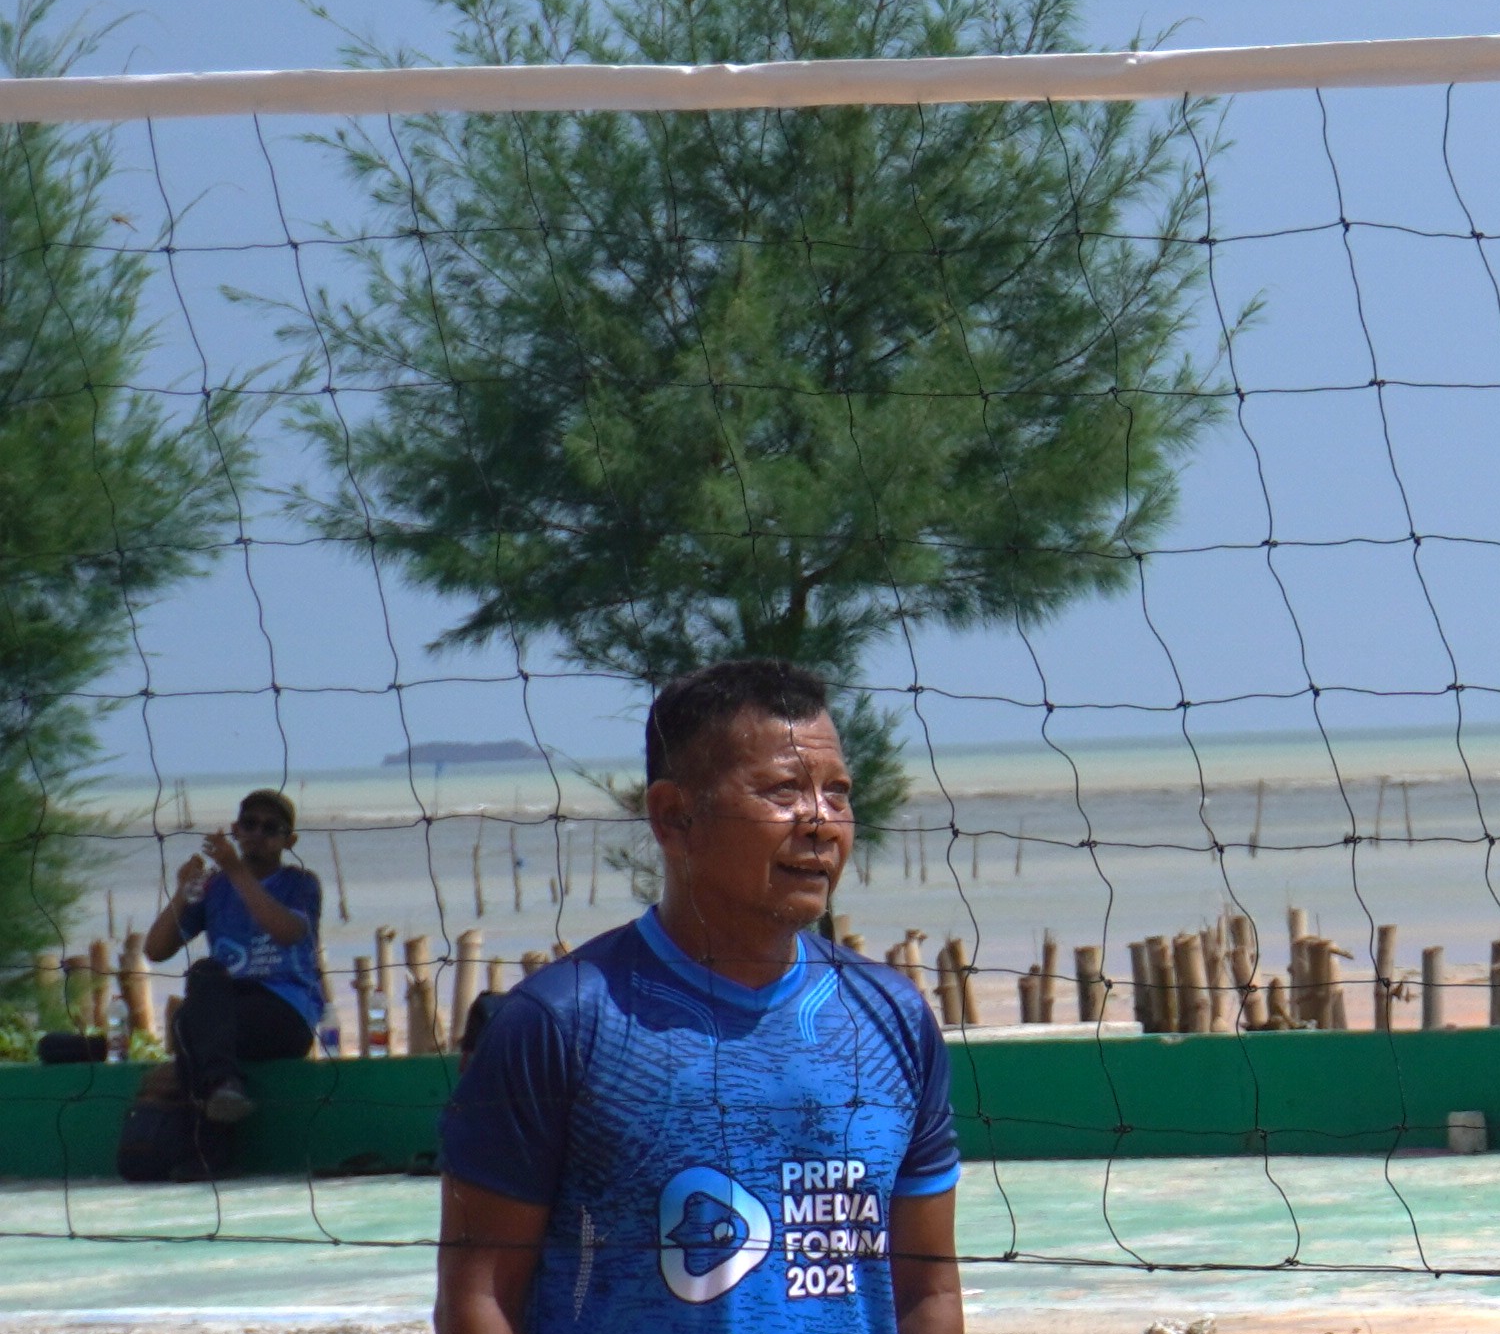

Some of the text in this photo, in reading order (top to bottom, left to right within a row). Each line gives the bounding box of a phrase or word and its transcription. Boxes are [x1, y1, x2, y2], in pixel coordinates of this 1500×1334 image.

[782, 1160, 866, 1191] PRPP
[783, 1193, 880, 1224] MEDIA
[785, 1229, 889, 1261] FORUM
[787, 1263, 857, 1297] 2025
